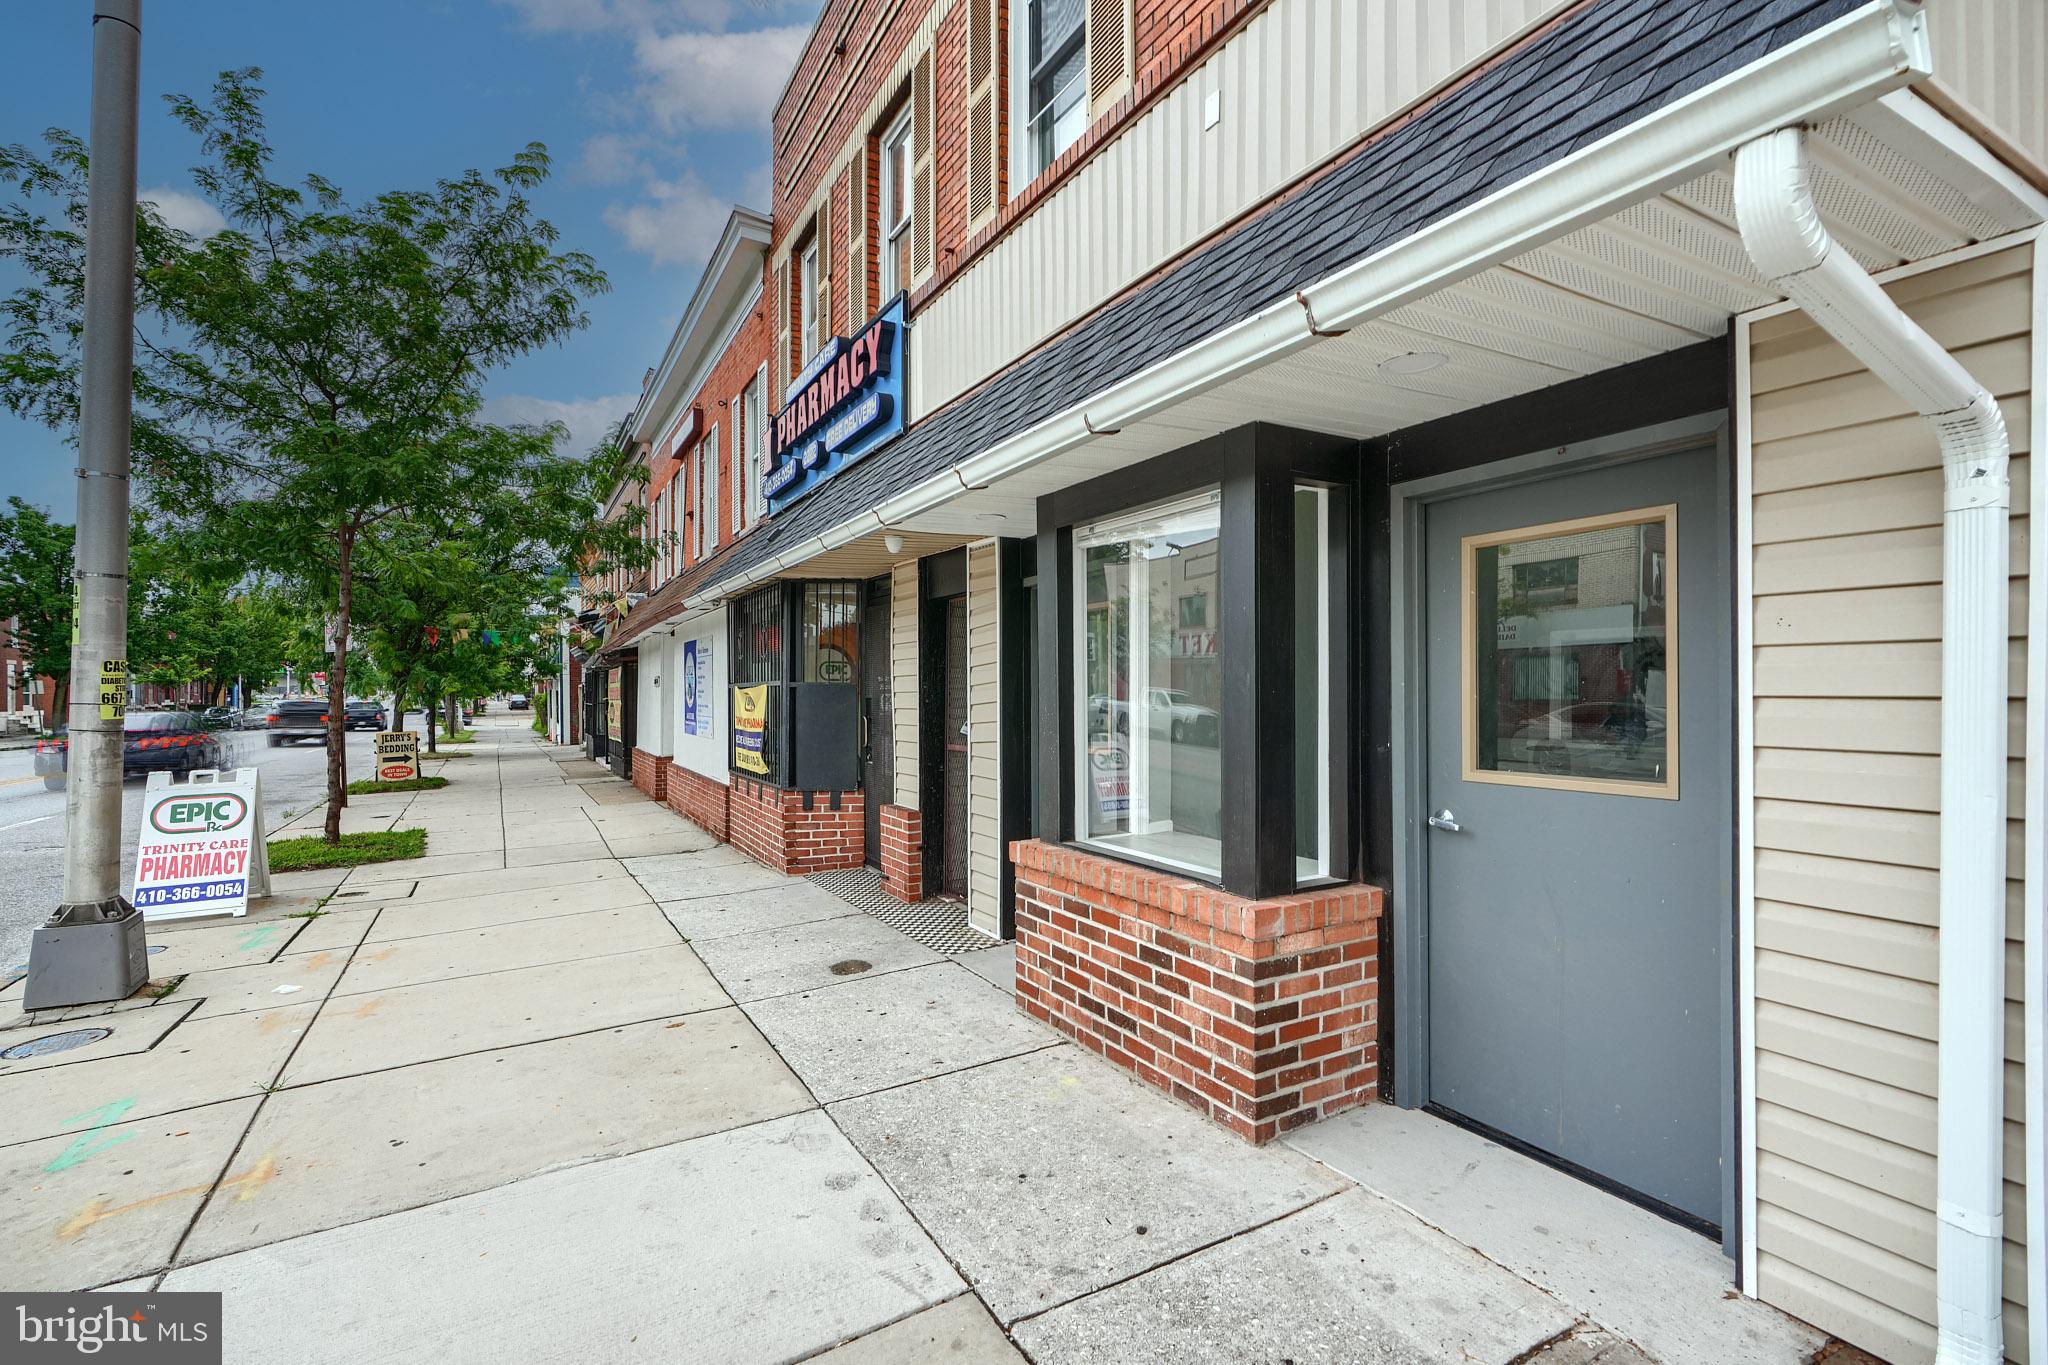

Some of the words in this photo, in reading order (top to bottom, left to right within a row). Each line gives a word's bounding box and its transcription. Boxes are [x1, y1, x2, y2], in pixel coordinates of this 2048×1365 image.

[777, 320, 881, 454] PHARMACY
[826, 664, 847, 674] EPIC
[381, 733, 412, 745] JERRY'S
[378, 744, 415, 754] BEDDING
[170, 801, 231, 823] EPIC
[142, 842, 205, 856] TRINITY
[209, 839, 249, 850] CARE
[140, 850, 248, 882] PHARMACY
[136, 882, 243, 904] 410-366-0054
